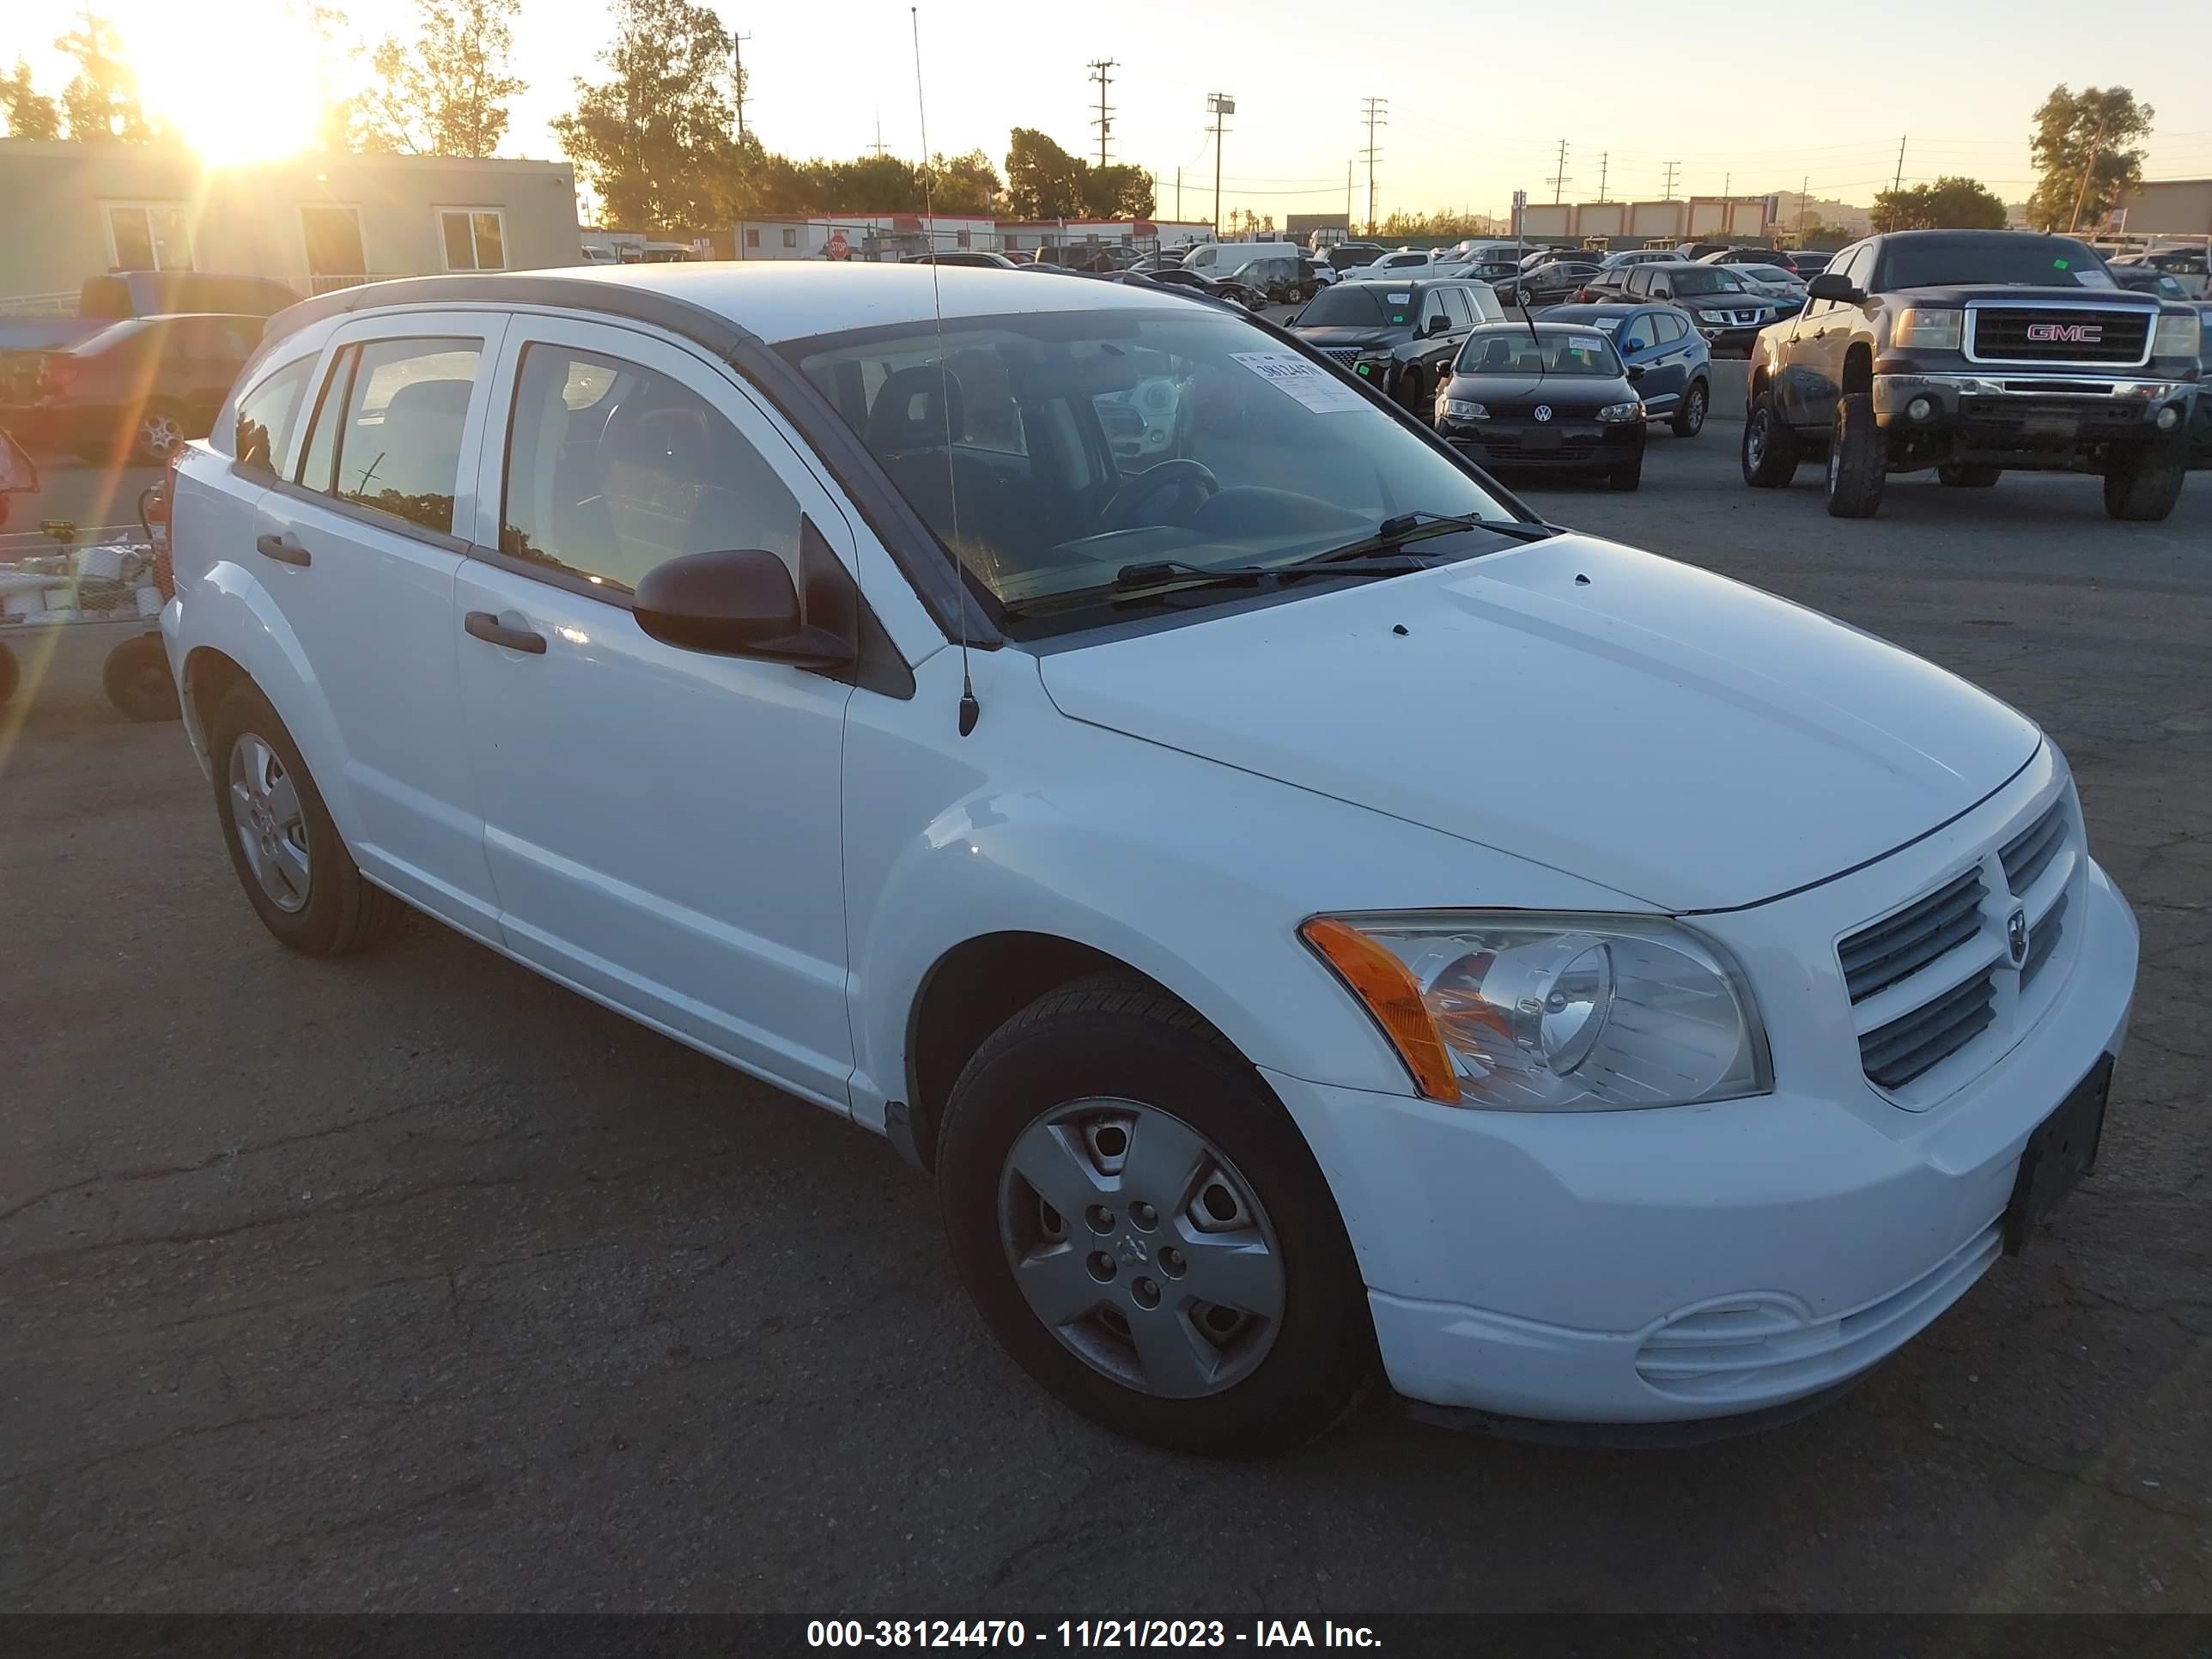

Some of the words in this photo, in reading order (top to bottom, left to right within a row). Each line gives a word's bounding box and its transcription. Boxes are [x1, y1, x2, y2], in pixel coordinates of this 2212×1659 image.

[831, 241, 847, 252] STOP
[2027, 324, 2103, 343] GMC
[1256, 364, 1323, 377] 38124470
